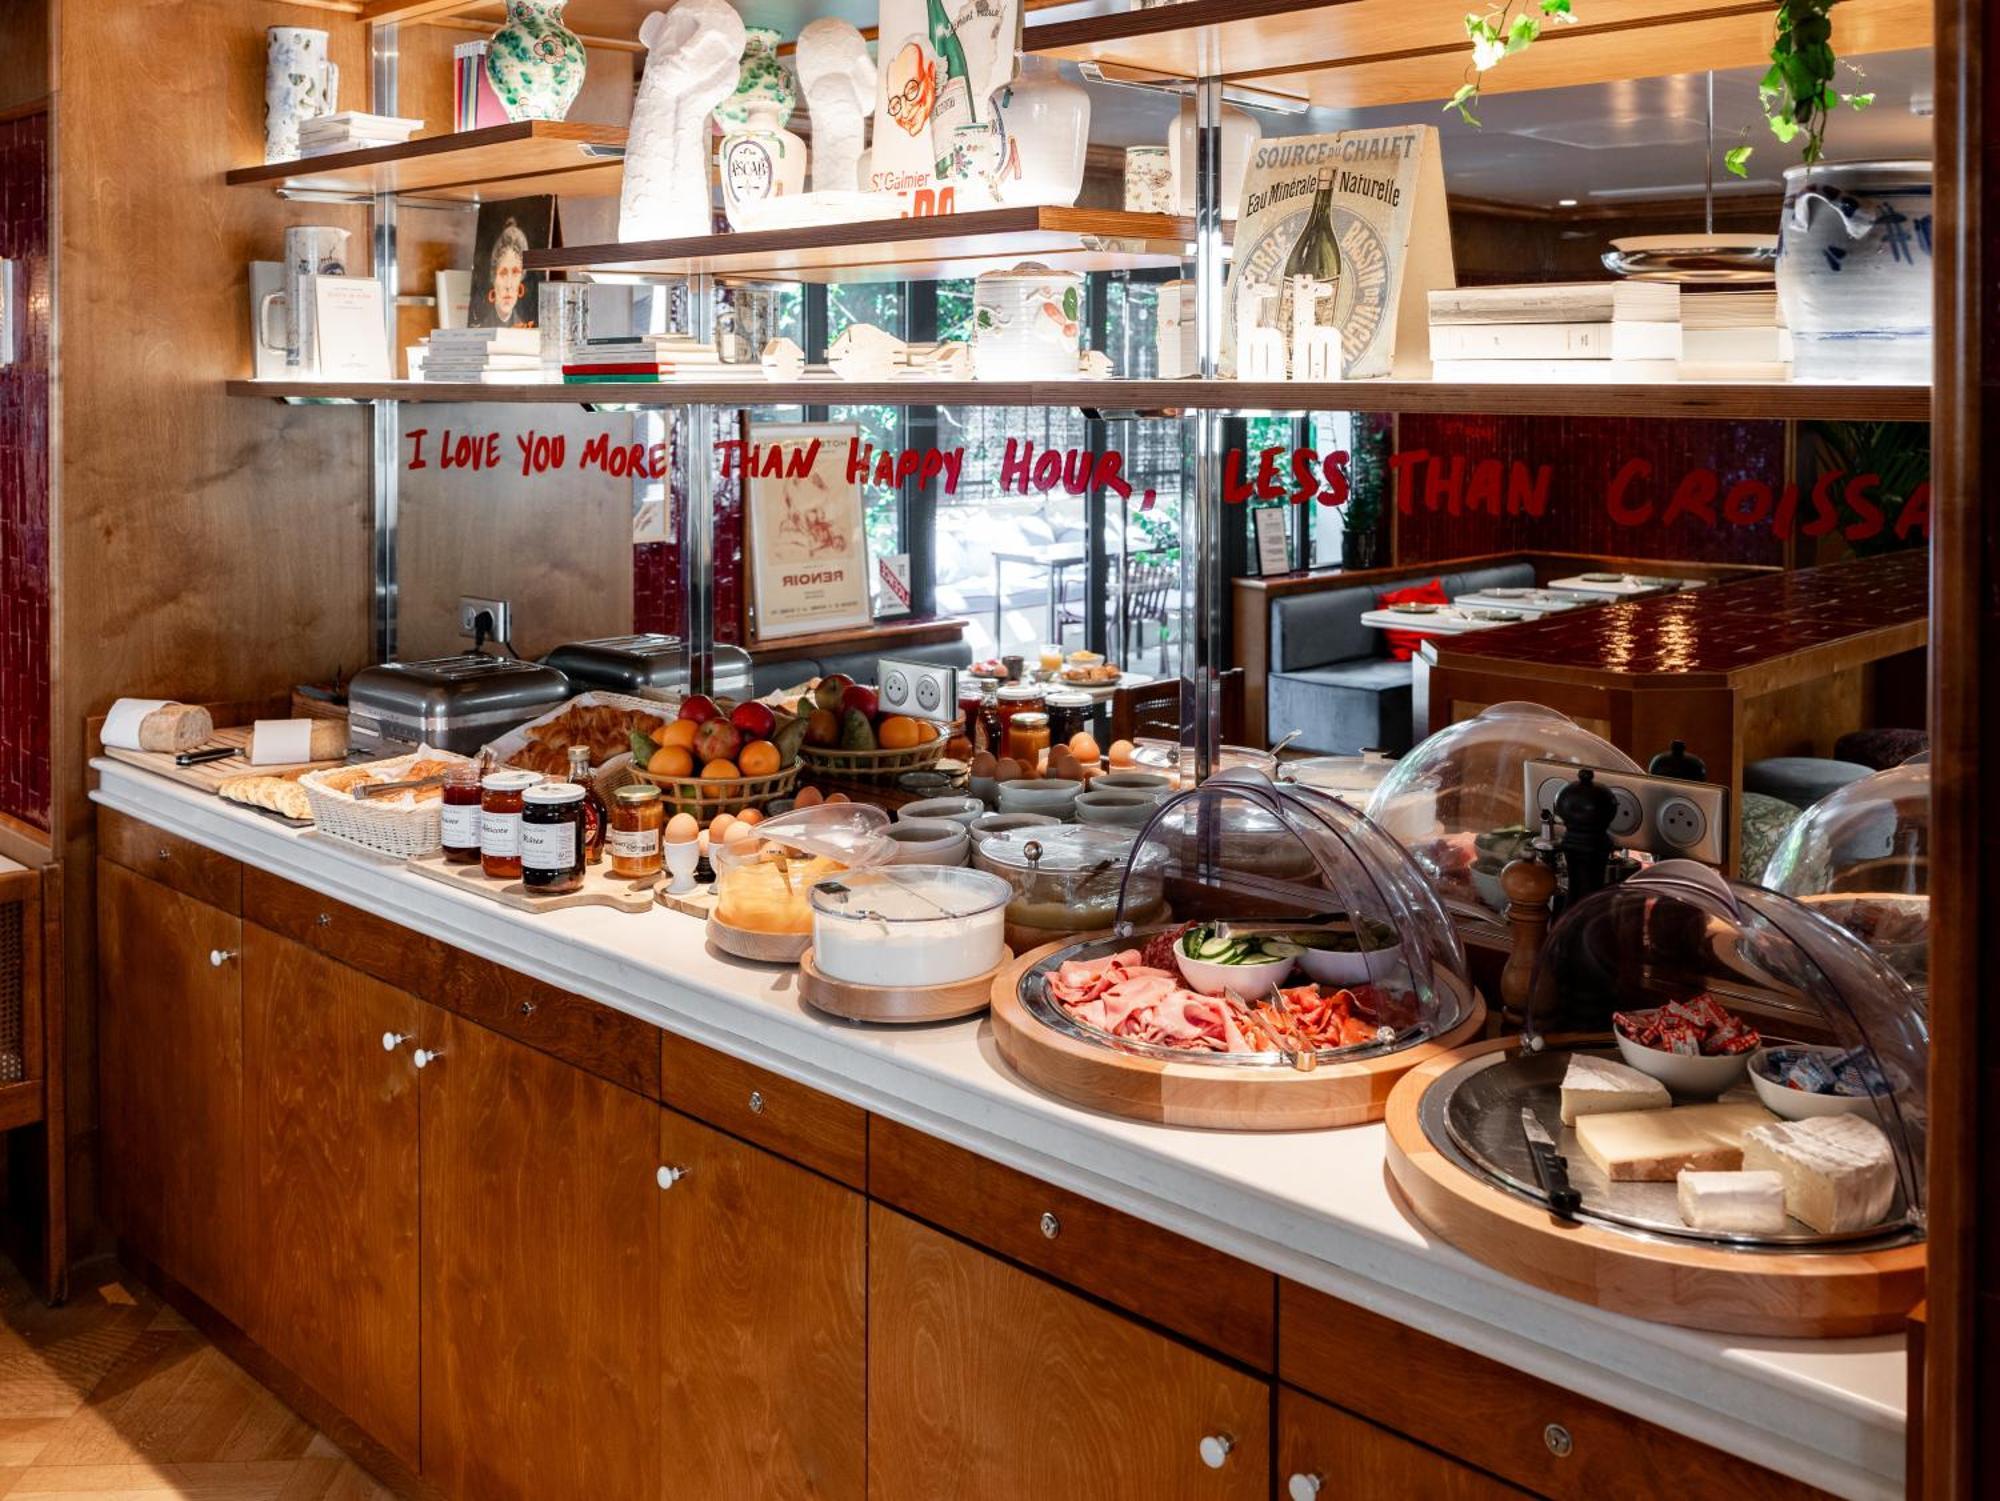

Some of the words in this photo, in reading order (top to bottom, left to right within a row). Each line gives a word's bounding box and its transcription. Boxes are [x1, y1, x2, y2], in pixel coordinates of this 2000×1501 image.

[1256, 143, 1328, 169] SOURCE
[1343, 135, 1416, 162] CHALET
[885, 170, 931, 191] Galmier
[1246, 192, 1268, 218] Eau
[1268, 174, 1317, 206] Minérale
[1339, 172, 1400, 207] Naturelle
[1341, 220, 1386, 288] BASSIN
[405, 429, 428, 471] I
[440, 431, 501, 470] LOVE
[517, 430, 566, 477] YOU
[580, 440, 667, 479] MORE
[713, 437, 822, 480] THAN
[846, 436, 965, 494] HAPPY
[1000, 437, 1157, 512] HOUR,
[1223, 446, 1350, 506] LESS
[1388, 448, 1553, 517] THAN
[1606, 457, 1931, 540] CROISSA
